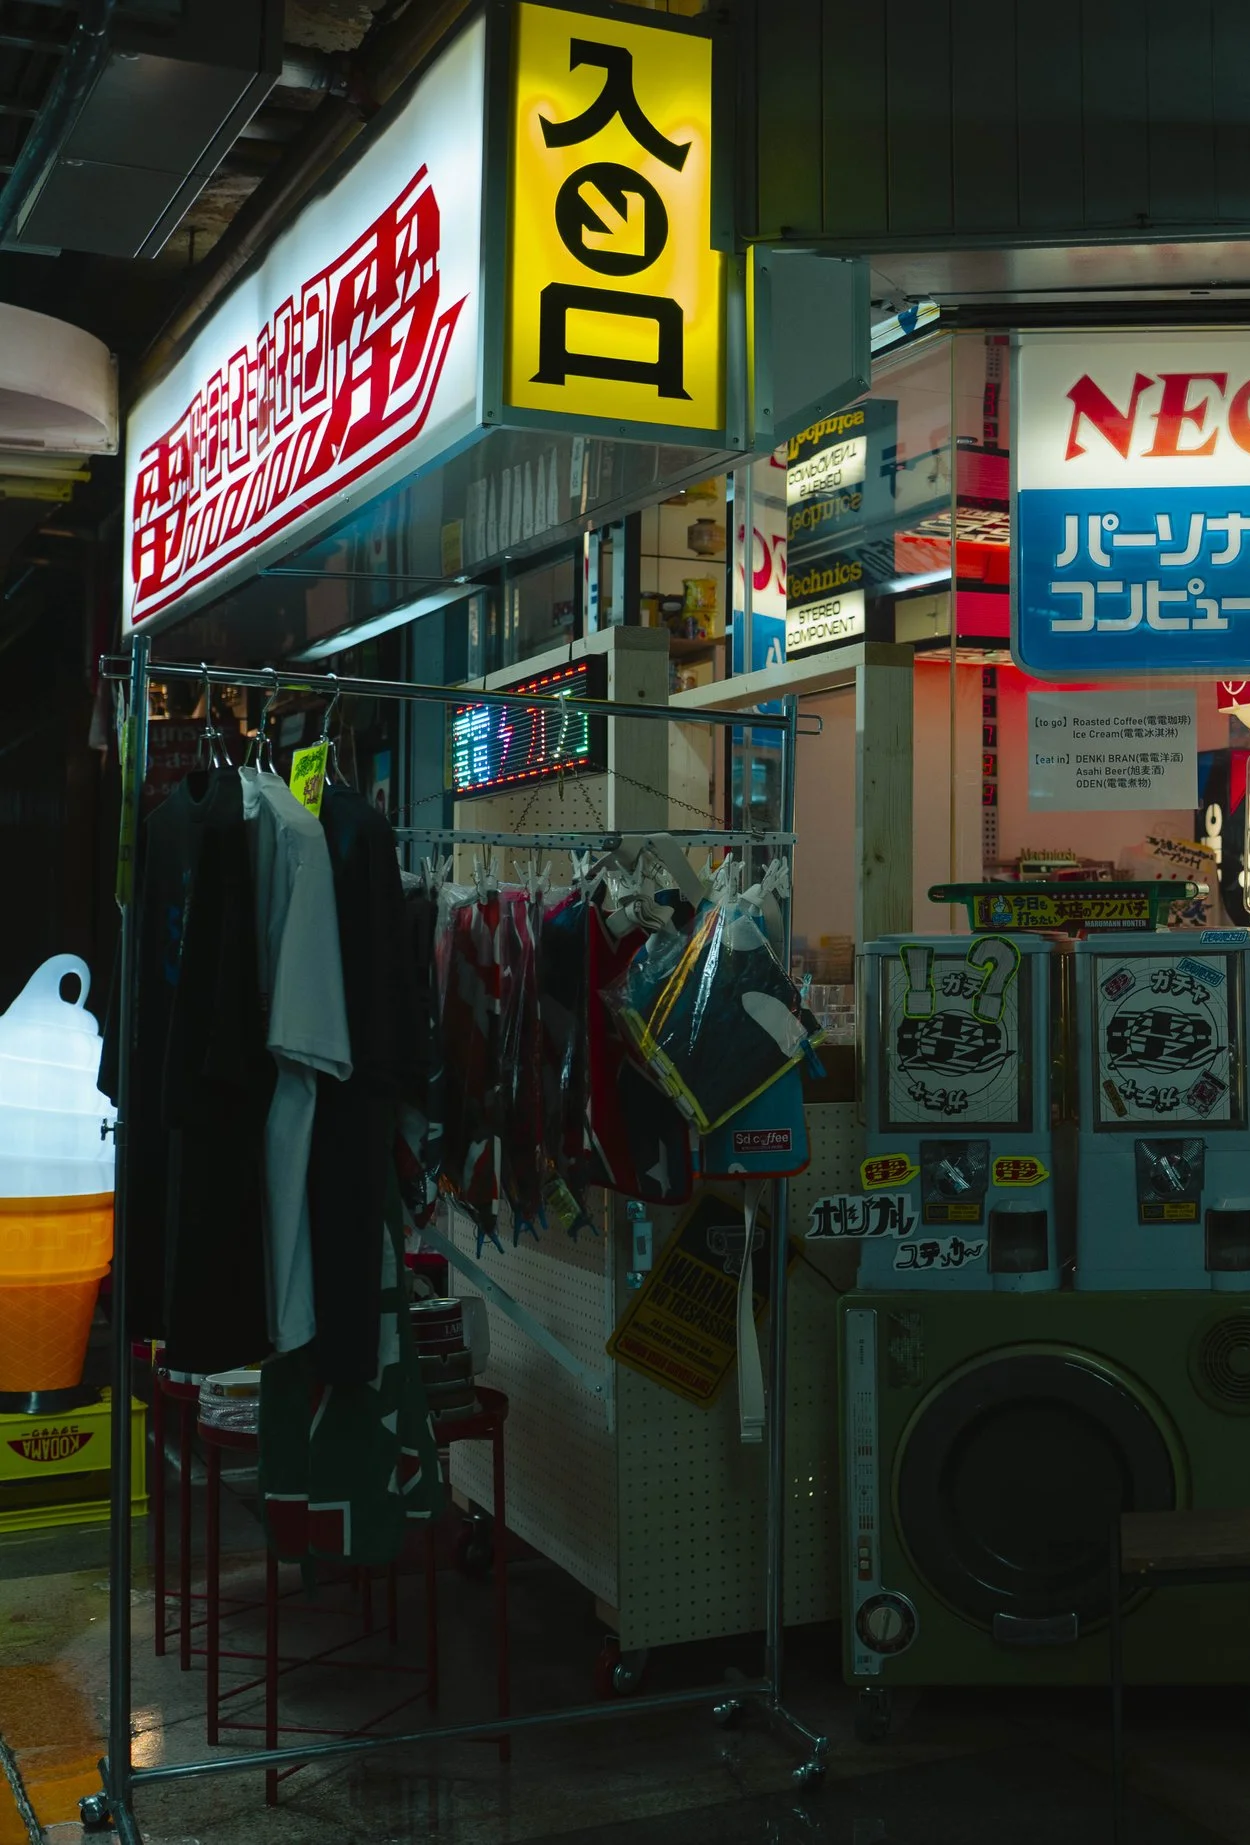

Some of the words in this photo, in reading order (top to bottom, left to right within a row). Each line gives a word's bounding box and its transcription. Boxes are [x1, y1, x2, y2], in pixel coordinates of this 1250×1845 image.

[799, 600, 841, 625] STEREO
[787, 615, 856, 647] COMPONENT
[1073, 717, 1111, 726] Roasted
[1073, 730, 1087, 739] Ice
[1076, 754, 1106, 764] DENKI
[1076, 767, 1102, 776] Asahi
[1151, 968, 1210, 1005] ガチャ
[646, 1281, 670, 1308] NO
[660, 1251, 764, 1321] WARNI
[22, 1435, 80, 1460] KODAMA
